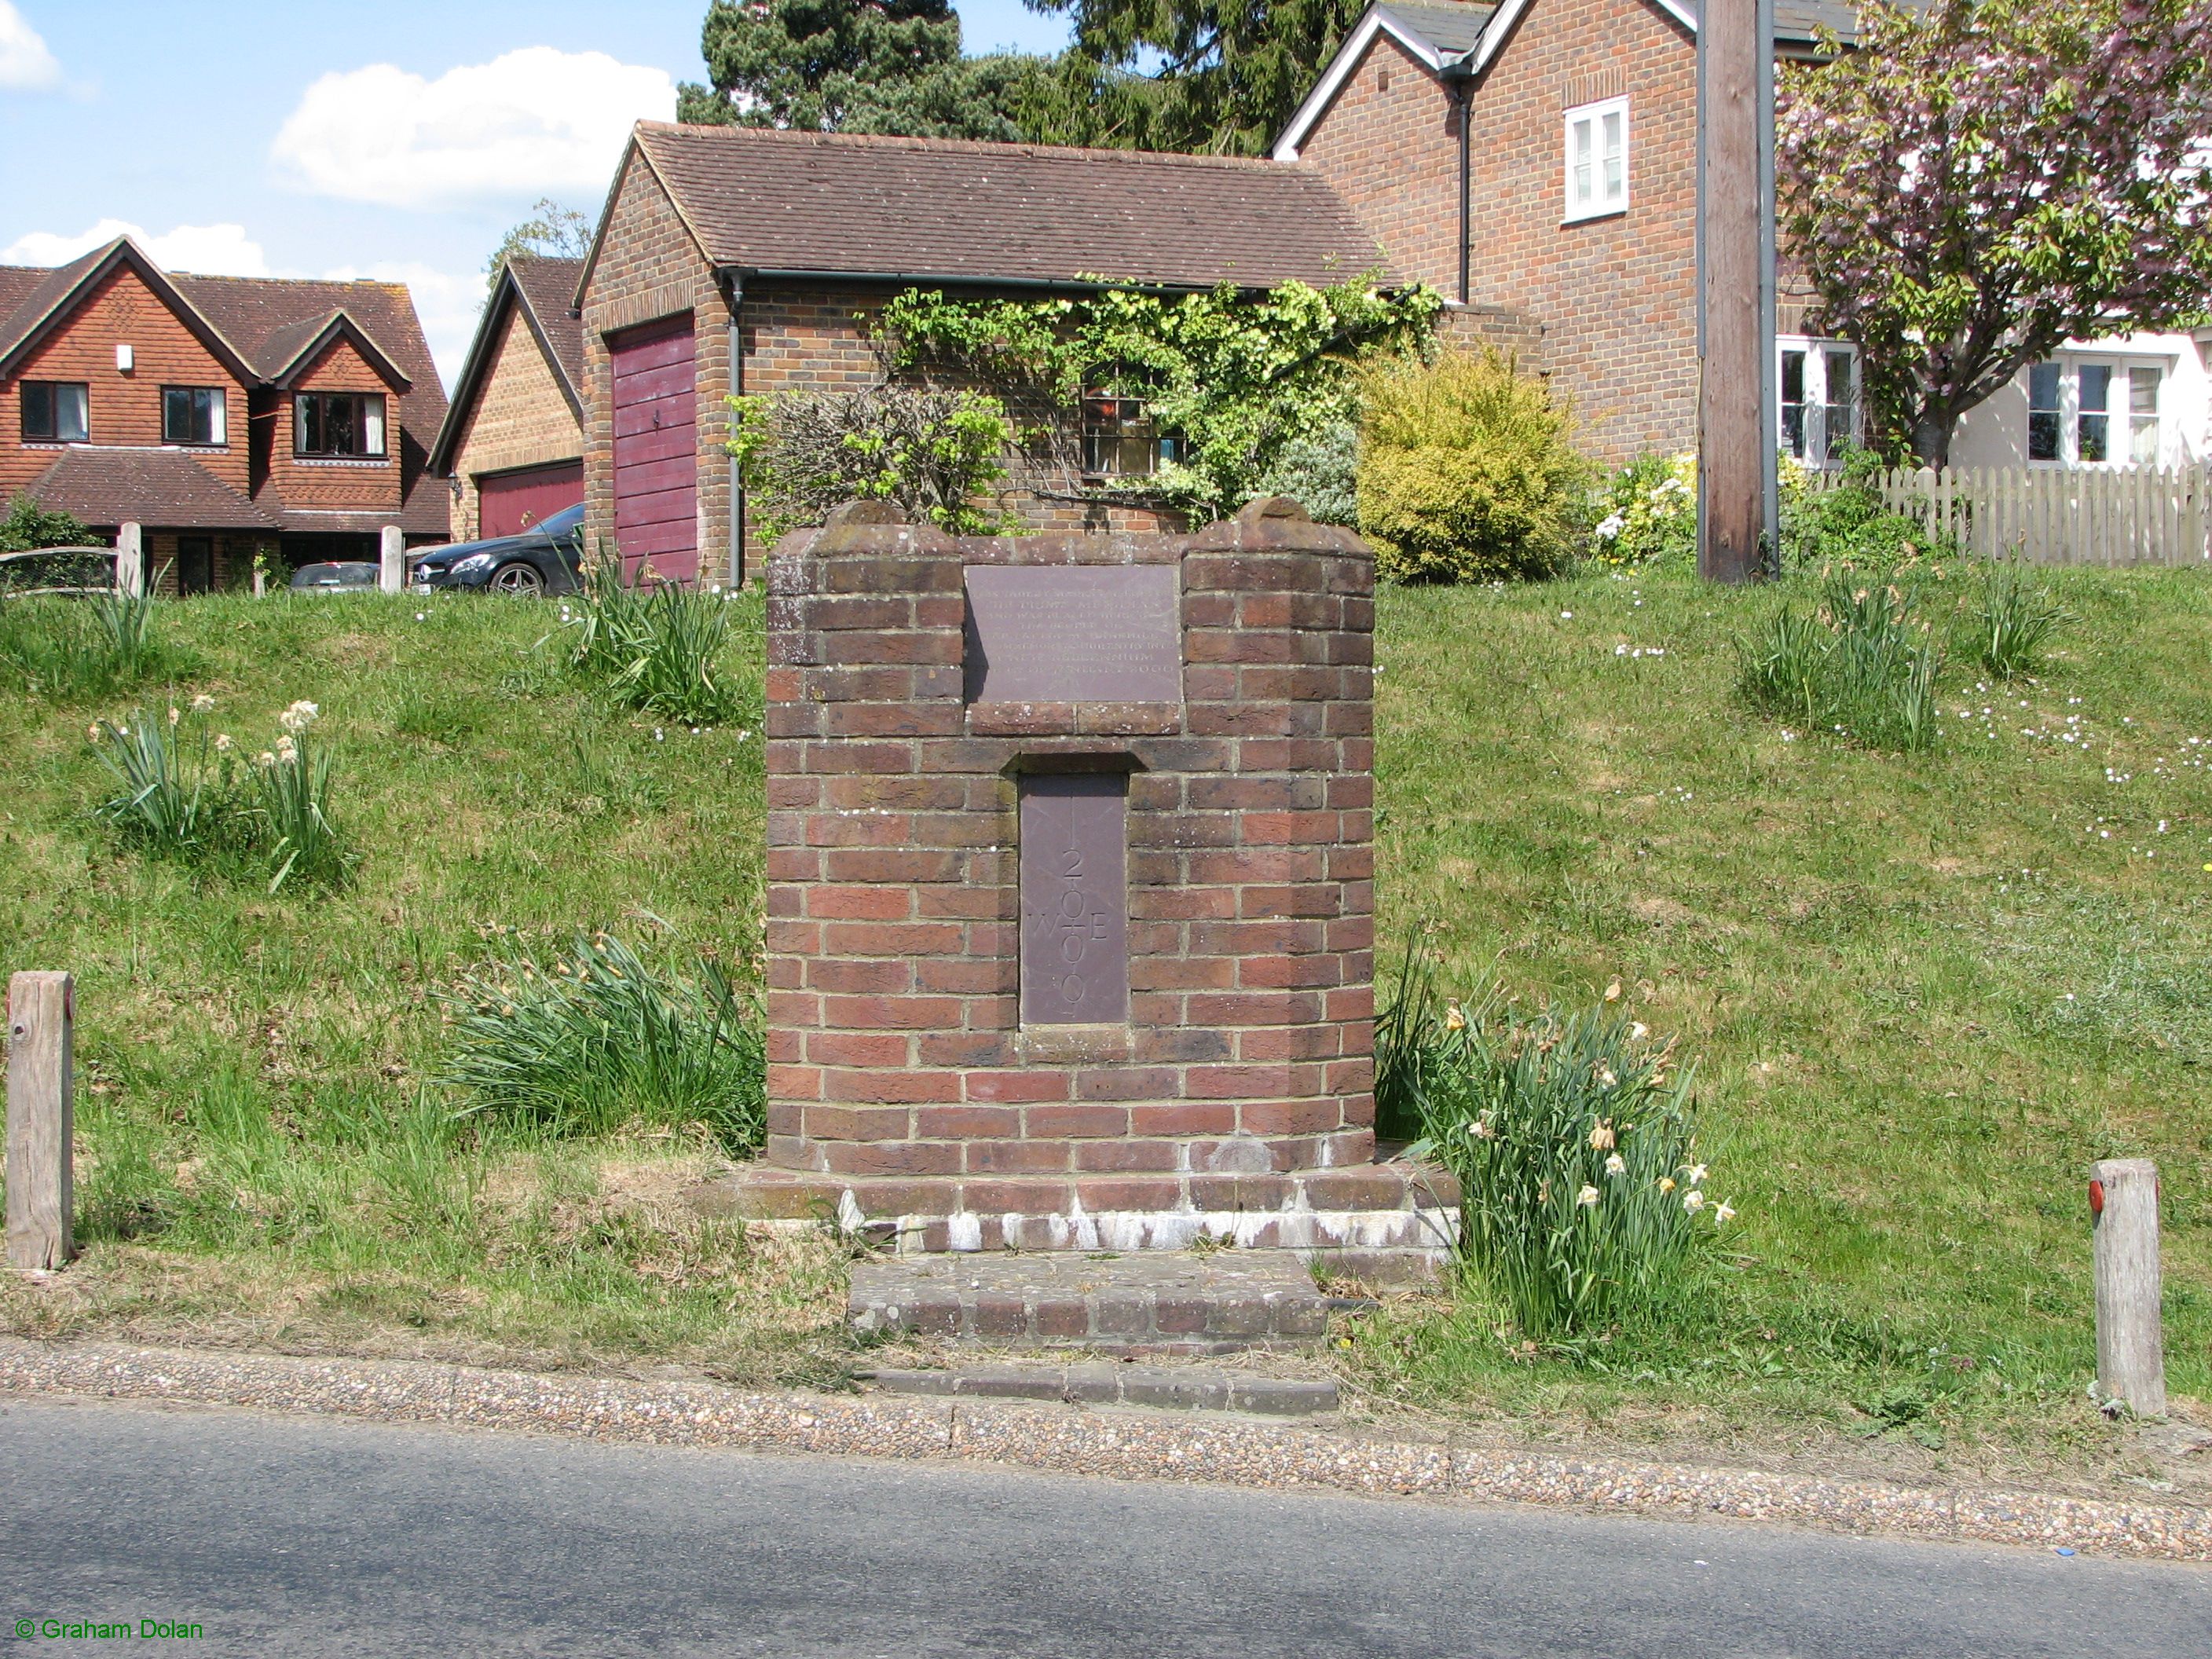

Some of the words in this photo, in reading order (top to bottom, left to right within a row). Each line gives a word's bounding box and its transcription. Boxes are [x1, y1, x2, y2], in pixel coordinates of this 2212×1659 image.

[1130, 665, 1175, 673] 2000
[1027, 913, 1061, 938] W
[1090, 911, 1108, 940] E
[1060, 848, 1085, 1003] 2000
